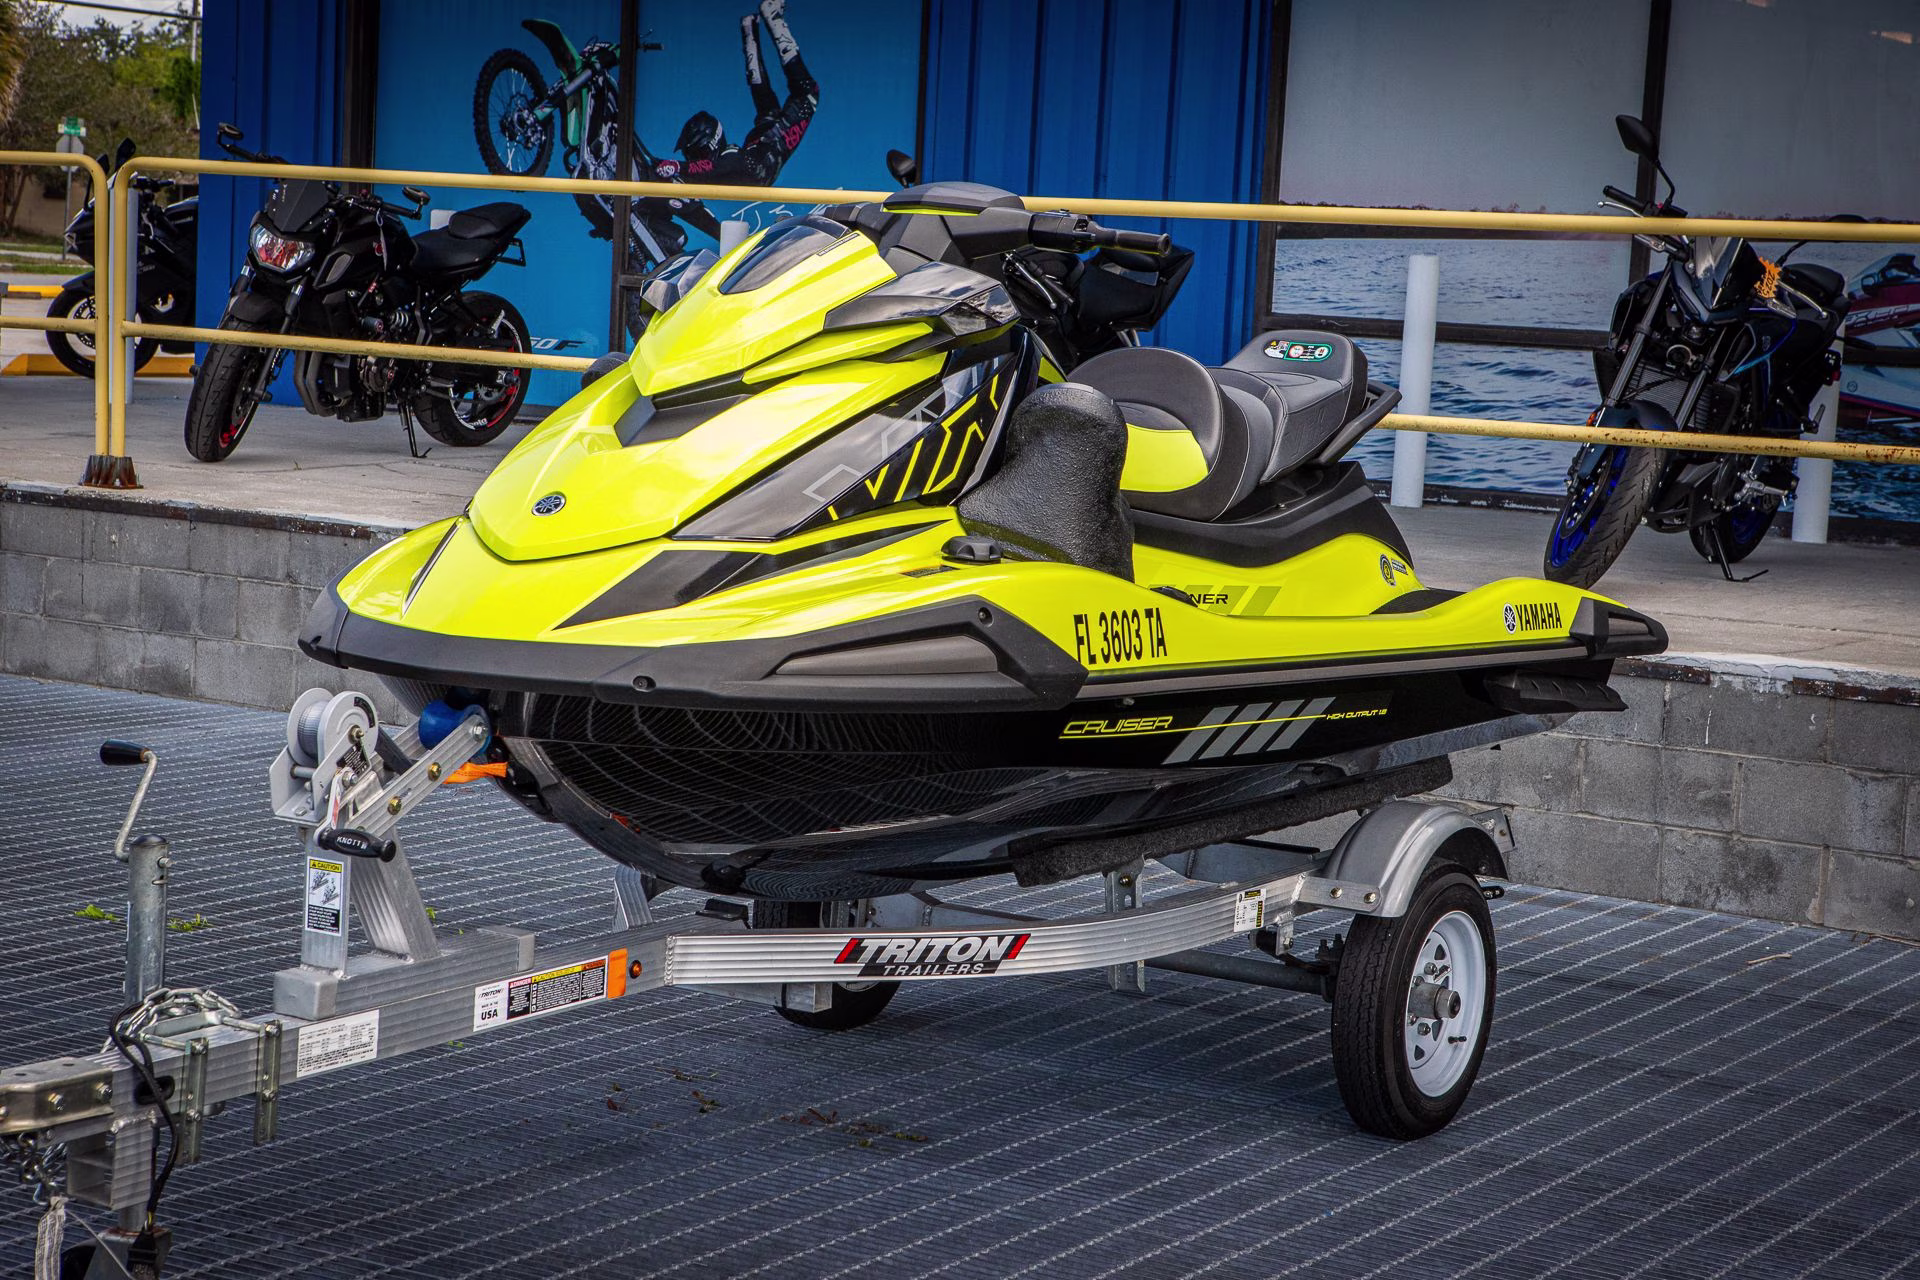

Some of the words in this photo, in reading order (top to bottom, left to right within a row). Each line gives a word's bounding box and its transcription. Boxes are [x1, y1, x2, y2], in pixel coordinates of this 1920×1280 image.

[1514, 602, 1563, 632] YAMAHA
[1073, 613, 1097, 665] FL
[1099, 608, 1143, 664] 3603
[1144, 607, 1168, 658] TA
[1345, 710, 1379, 719] OUTPUT
[1062, 716, 1173, 734] CRUISER
[317, 862, 340, 871] CAUTION
[857, 935, 1015, 963] TRITON
[883, 963, 984, 976] TRAILERS
[480, 989, 502, 998] TRITON
[481, 1008, 498, 1020] USA
